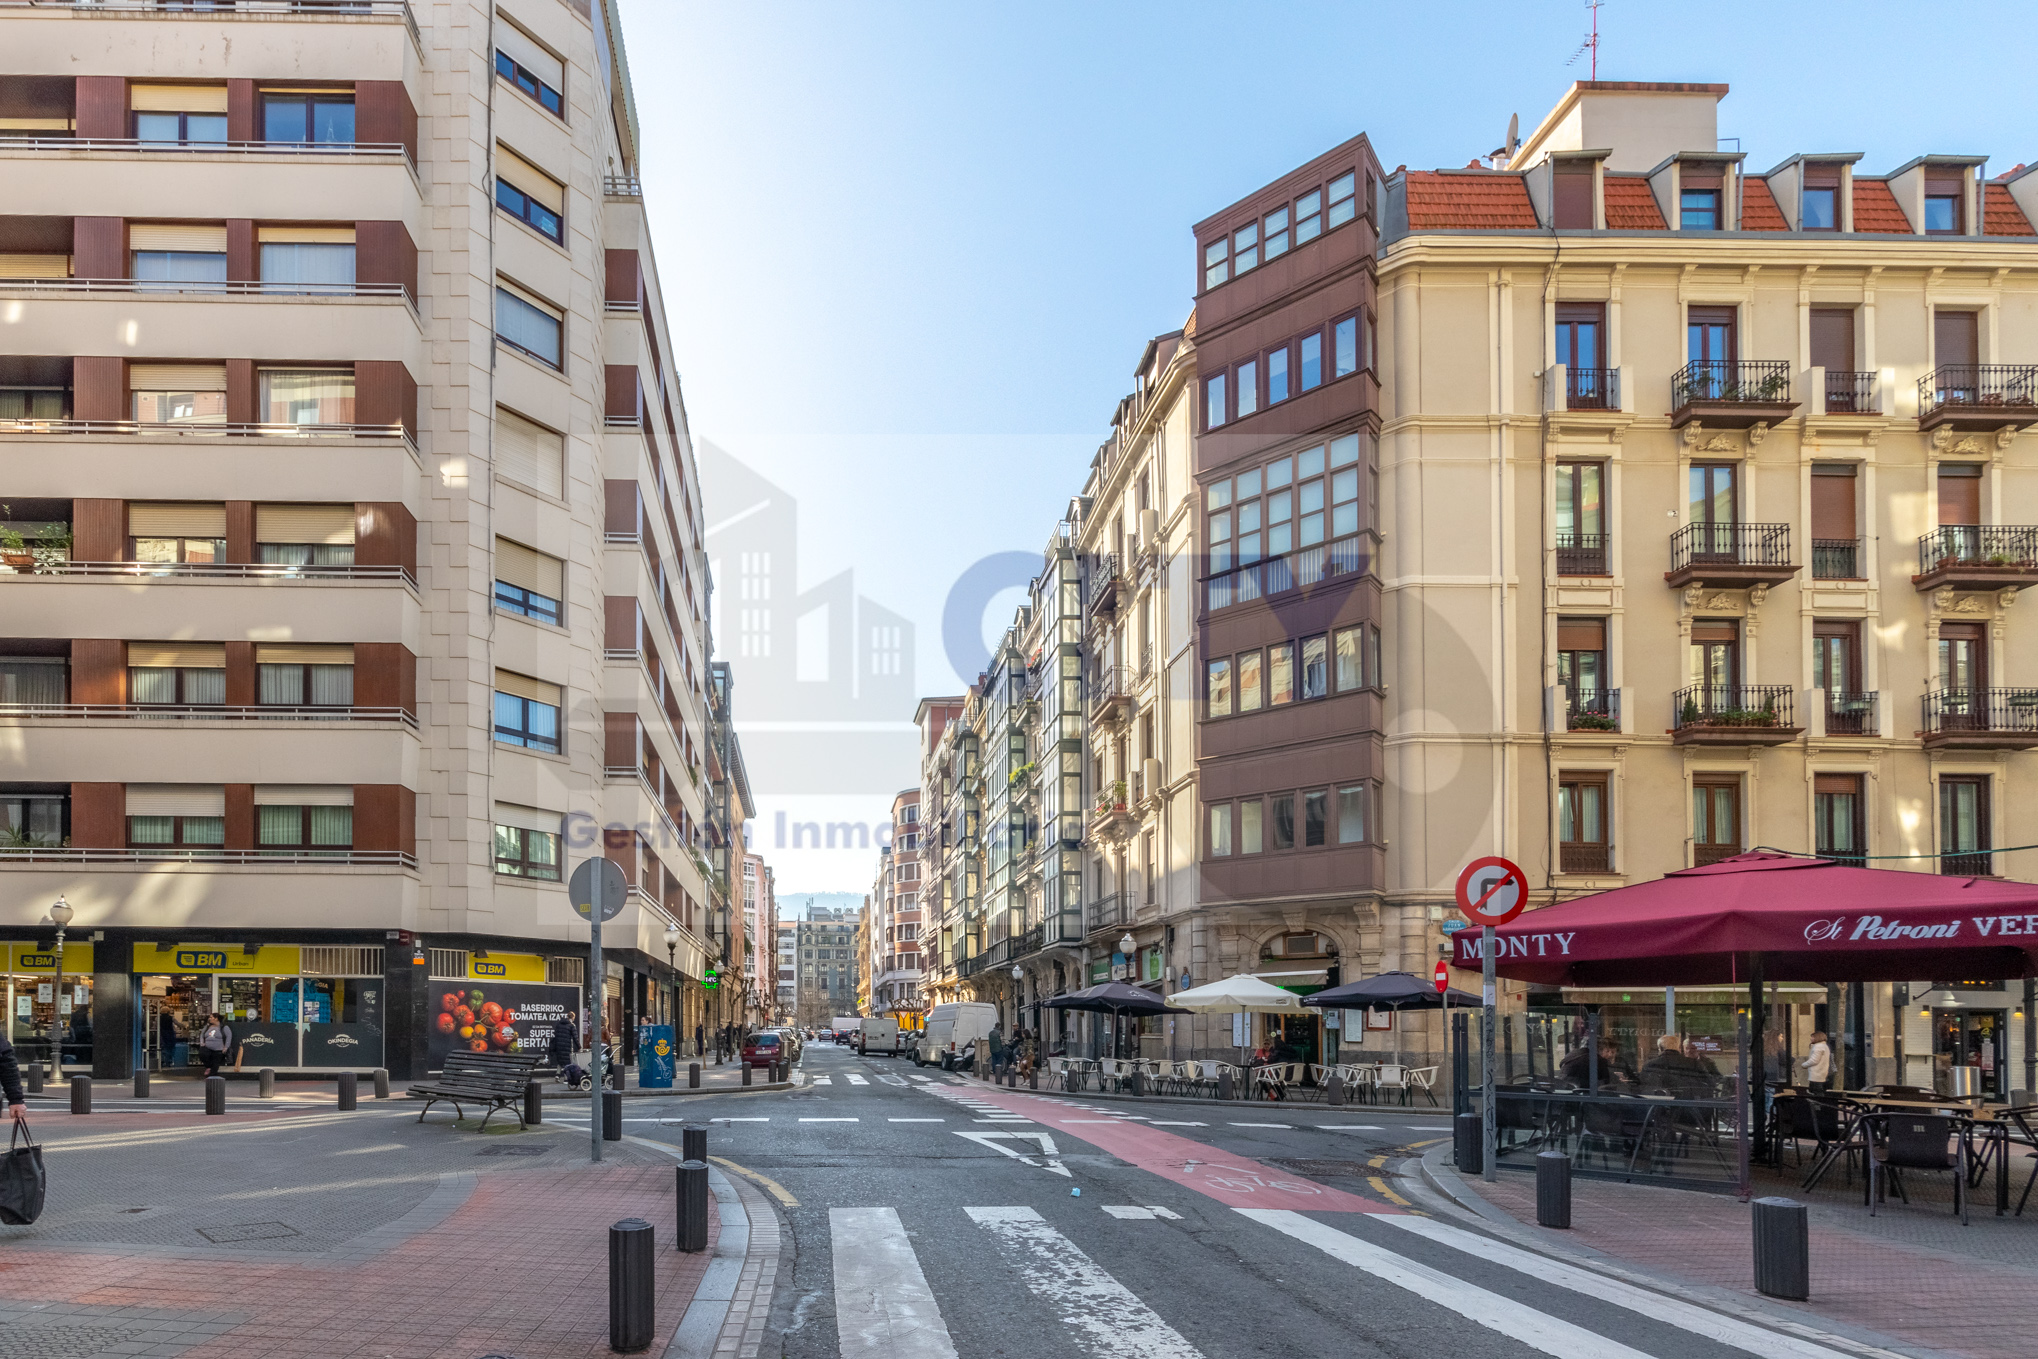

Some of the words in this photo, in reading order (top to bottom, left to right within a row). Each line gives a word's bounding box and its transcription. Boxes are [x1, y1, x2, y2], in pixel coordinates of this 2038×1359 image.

[1804, 916, 1846, 946] St
[1849, 915, 1962, 940] Petroni
[1461, 932, 1576, 960] MONTY
[35, 957, 53, 966] BM
[197, 954, 223, 966] BM
[487, 965, 504, 974] BM
[520, 1003, 565, 1013] BASERRIKO
[510, 1012, 548, 1021] TOMATEA
[529, 1029, 556, 1038] SUPER
[517, 1037, 550, 1048] BERTA
